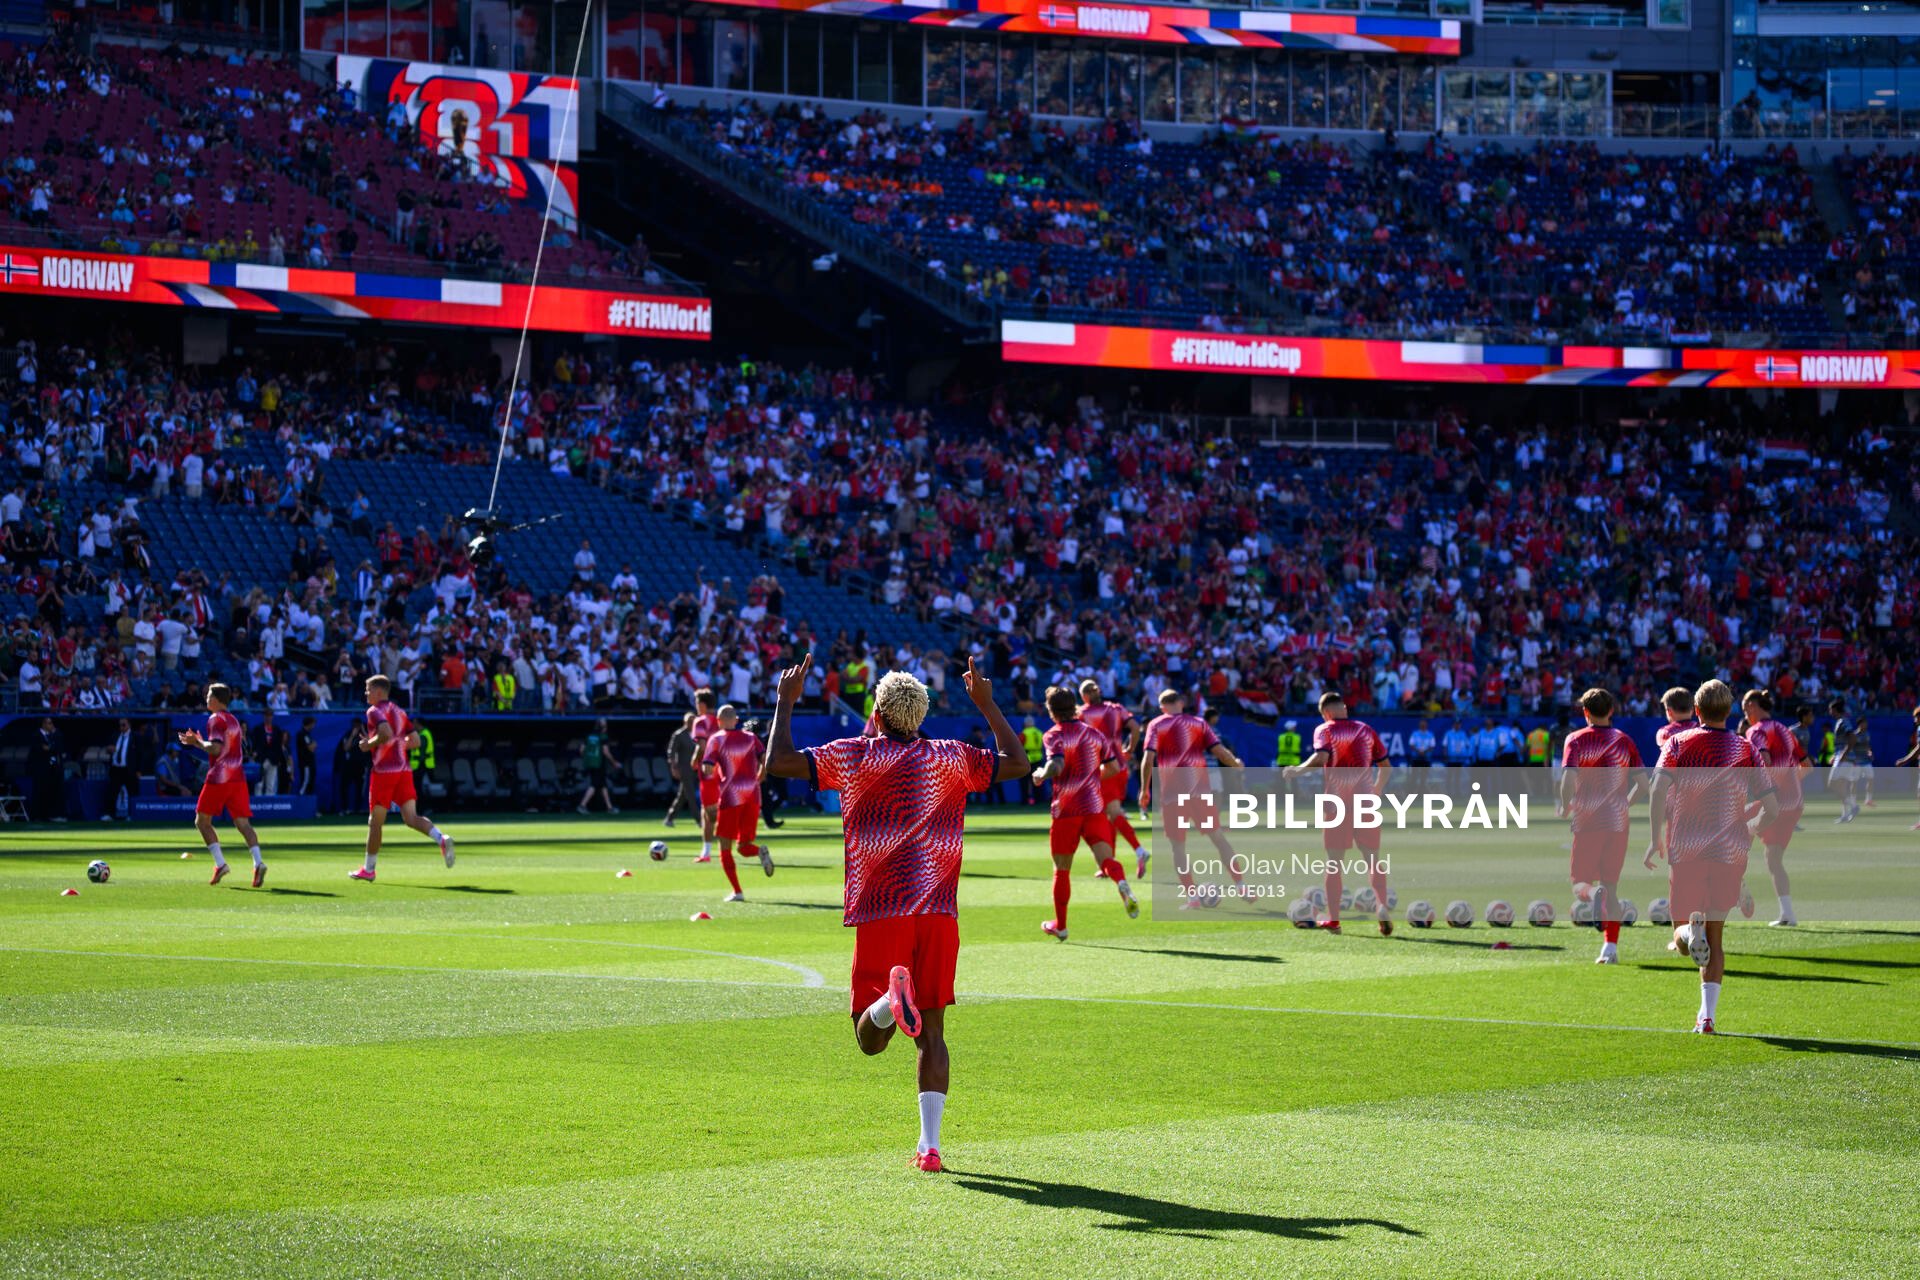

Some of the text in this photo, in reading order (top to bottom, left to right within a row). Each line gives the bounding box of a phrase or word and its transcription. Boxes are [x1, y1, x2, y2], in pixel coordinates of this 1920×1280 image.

[1077, 6, 1150, 34] NORWAY
[42, 256, 134, 293] NORWAY
[608, 299, 712, 333] #FIFAWorld
[1171, 337, 1301, 374] #FIFAWorldCup
[1801, 356, 1888, 382] NORWAY
[1380, 732, 1405, 757] FA
